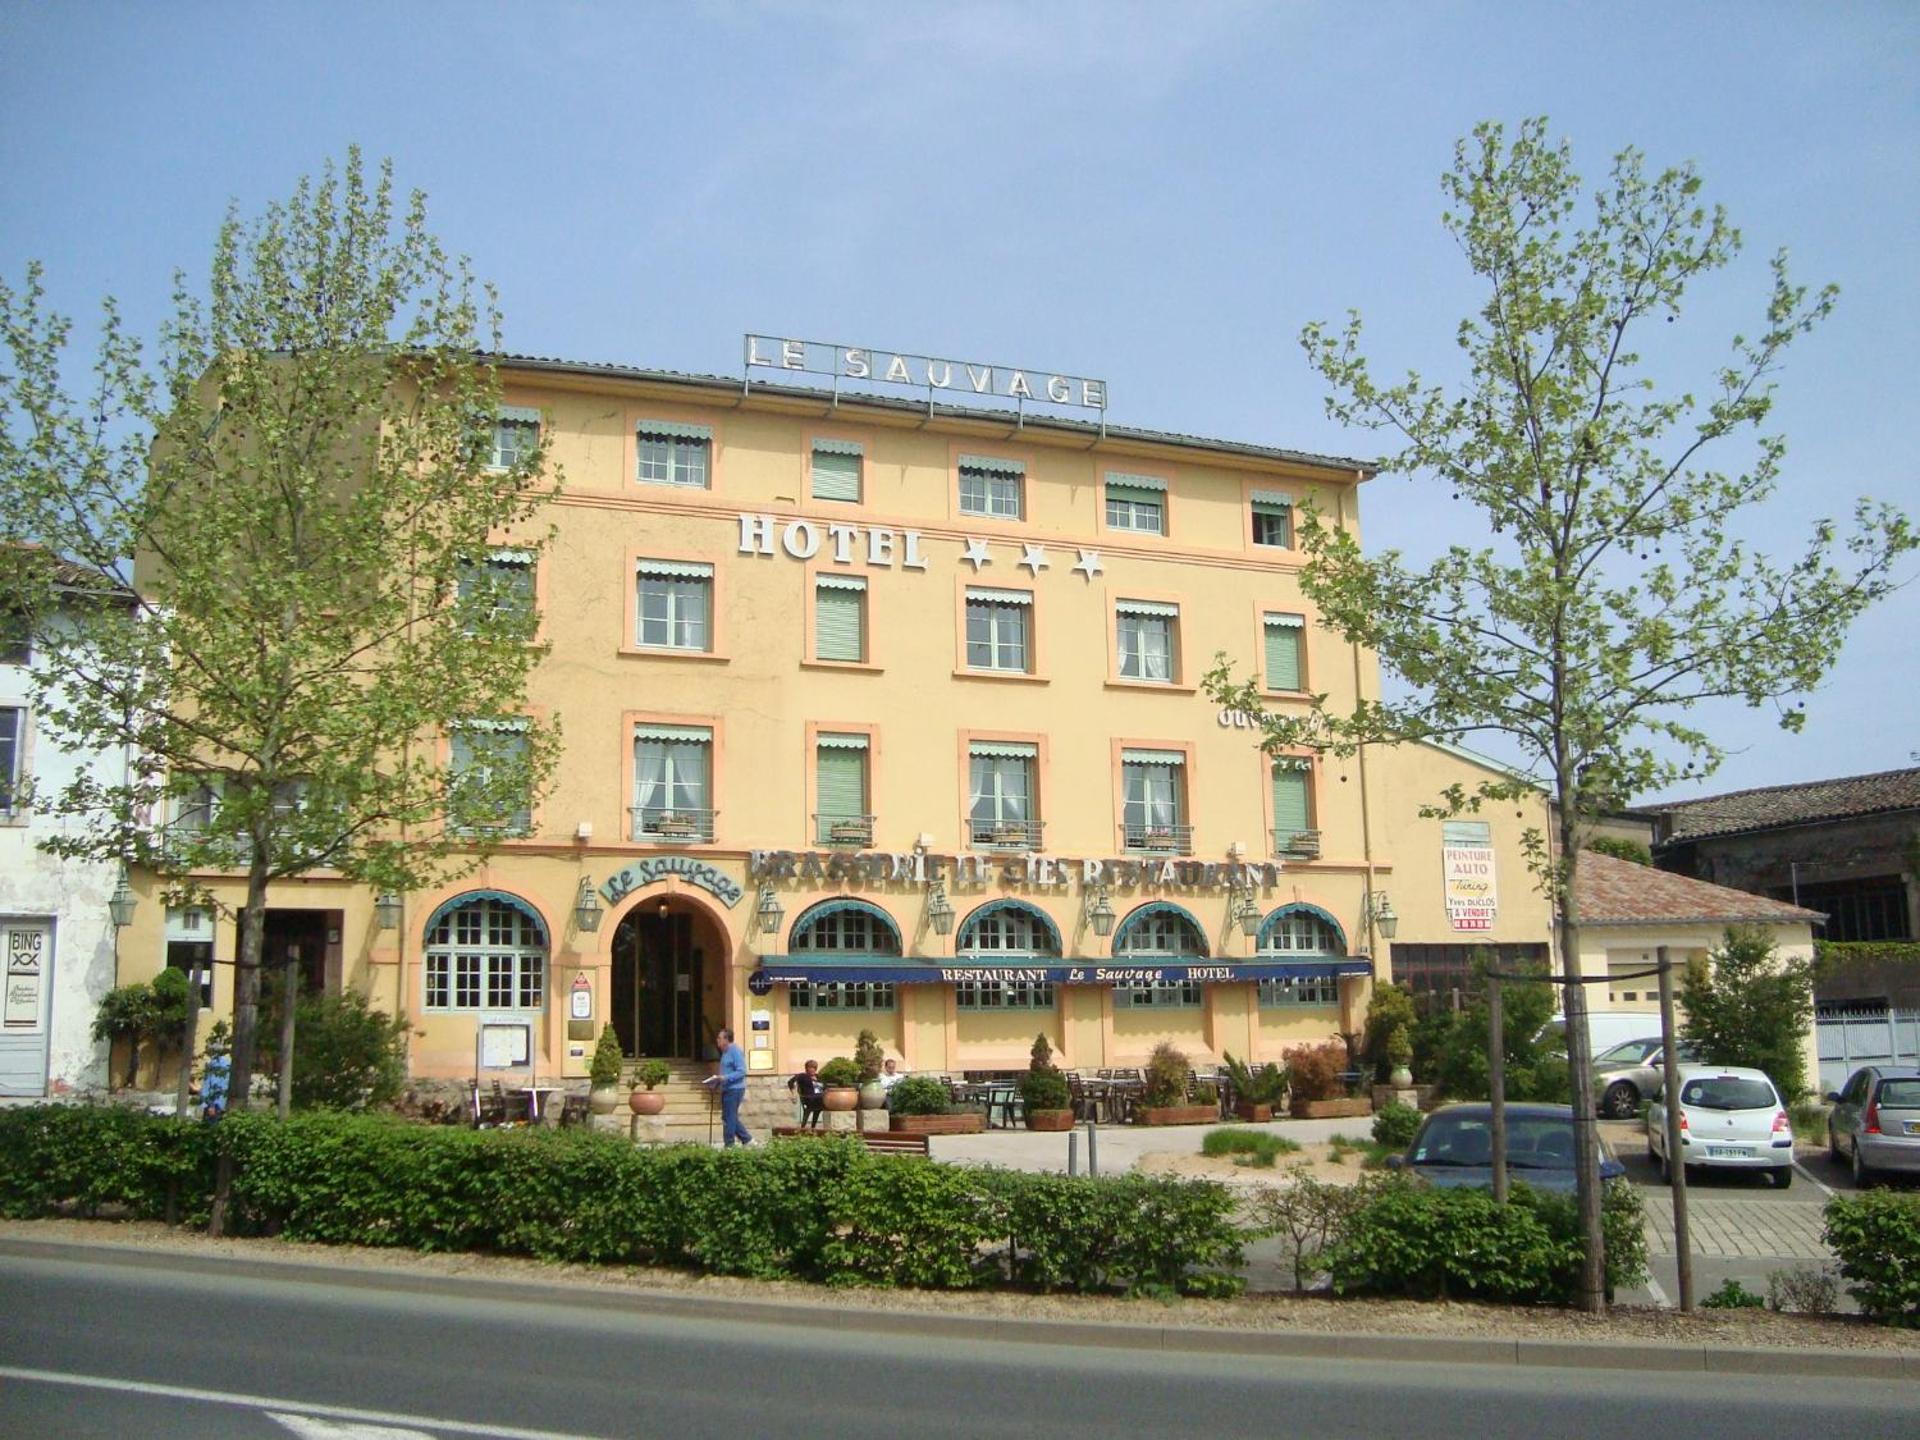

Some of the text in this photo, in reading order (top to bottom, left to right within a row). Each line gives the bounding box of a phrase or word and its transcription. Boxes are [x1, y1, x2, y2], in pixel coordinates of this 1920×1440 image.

[751, 336, 1103, 408] LE SAUVAGE
[739, 513, 928, 569] HOTEL
[1447, 850, 1492, 861] PEINTURE
[1454, 863, 1488, 874] AUTO
[639, 858, 741, 902] Sauvage
[1449, 897, 1496, 907] Yves DUCLOS
[1463, 908, 1490, 917] VENDRE
[12, 933, 42, 951] BING
[942, 967, 1234, 982] RESTAURANT Le Sauvage HOTEL
